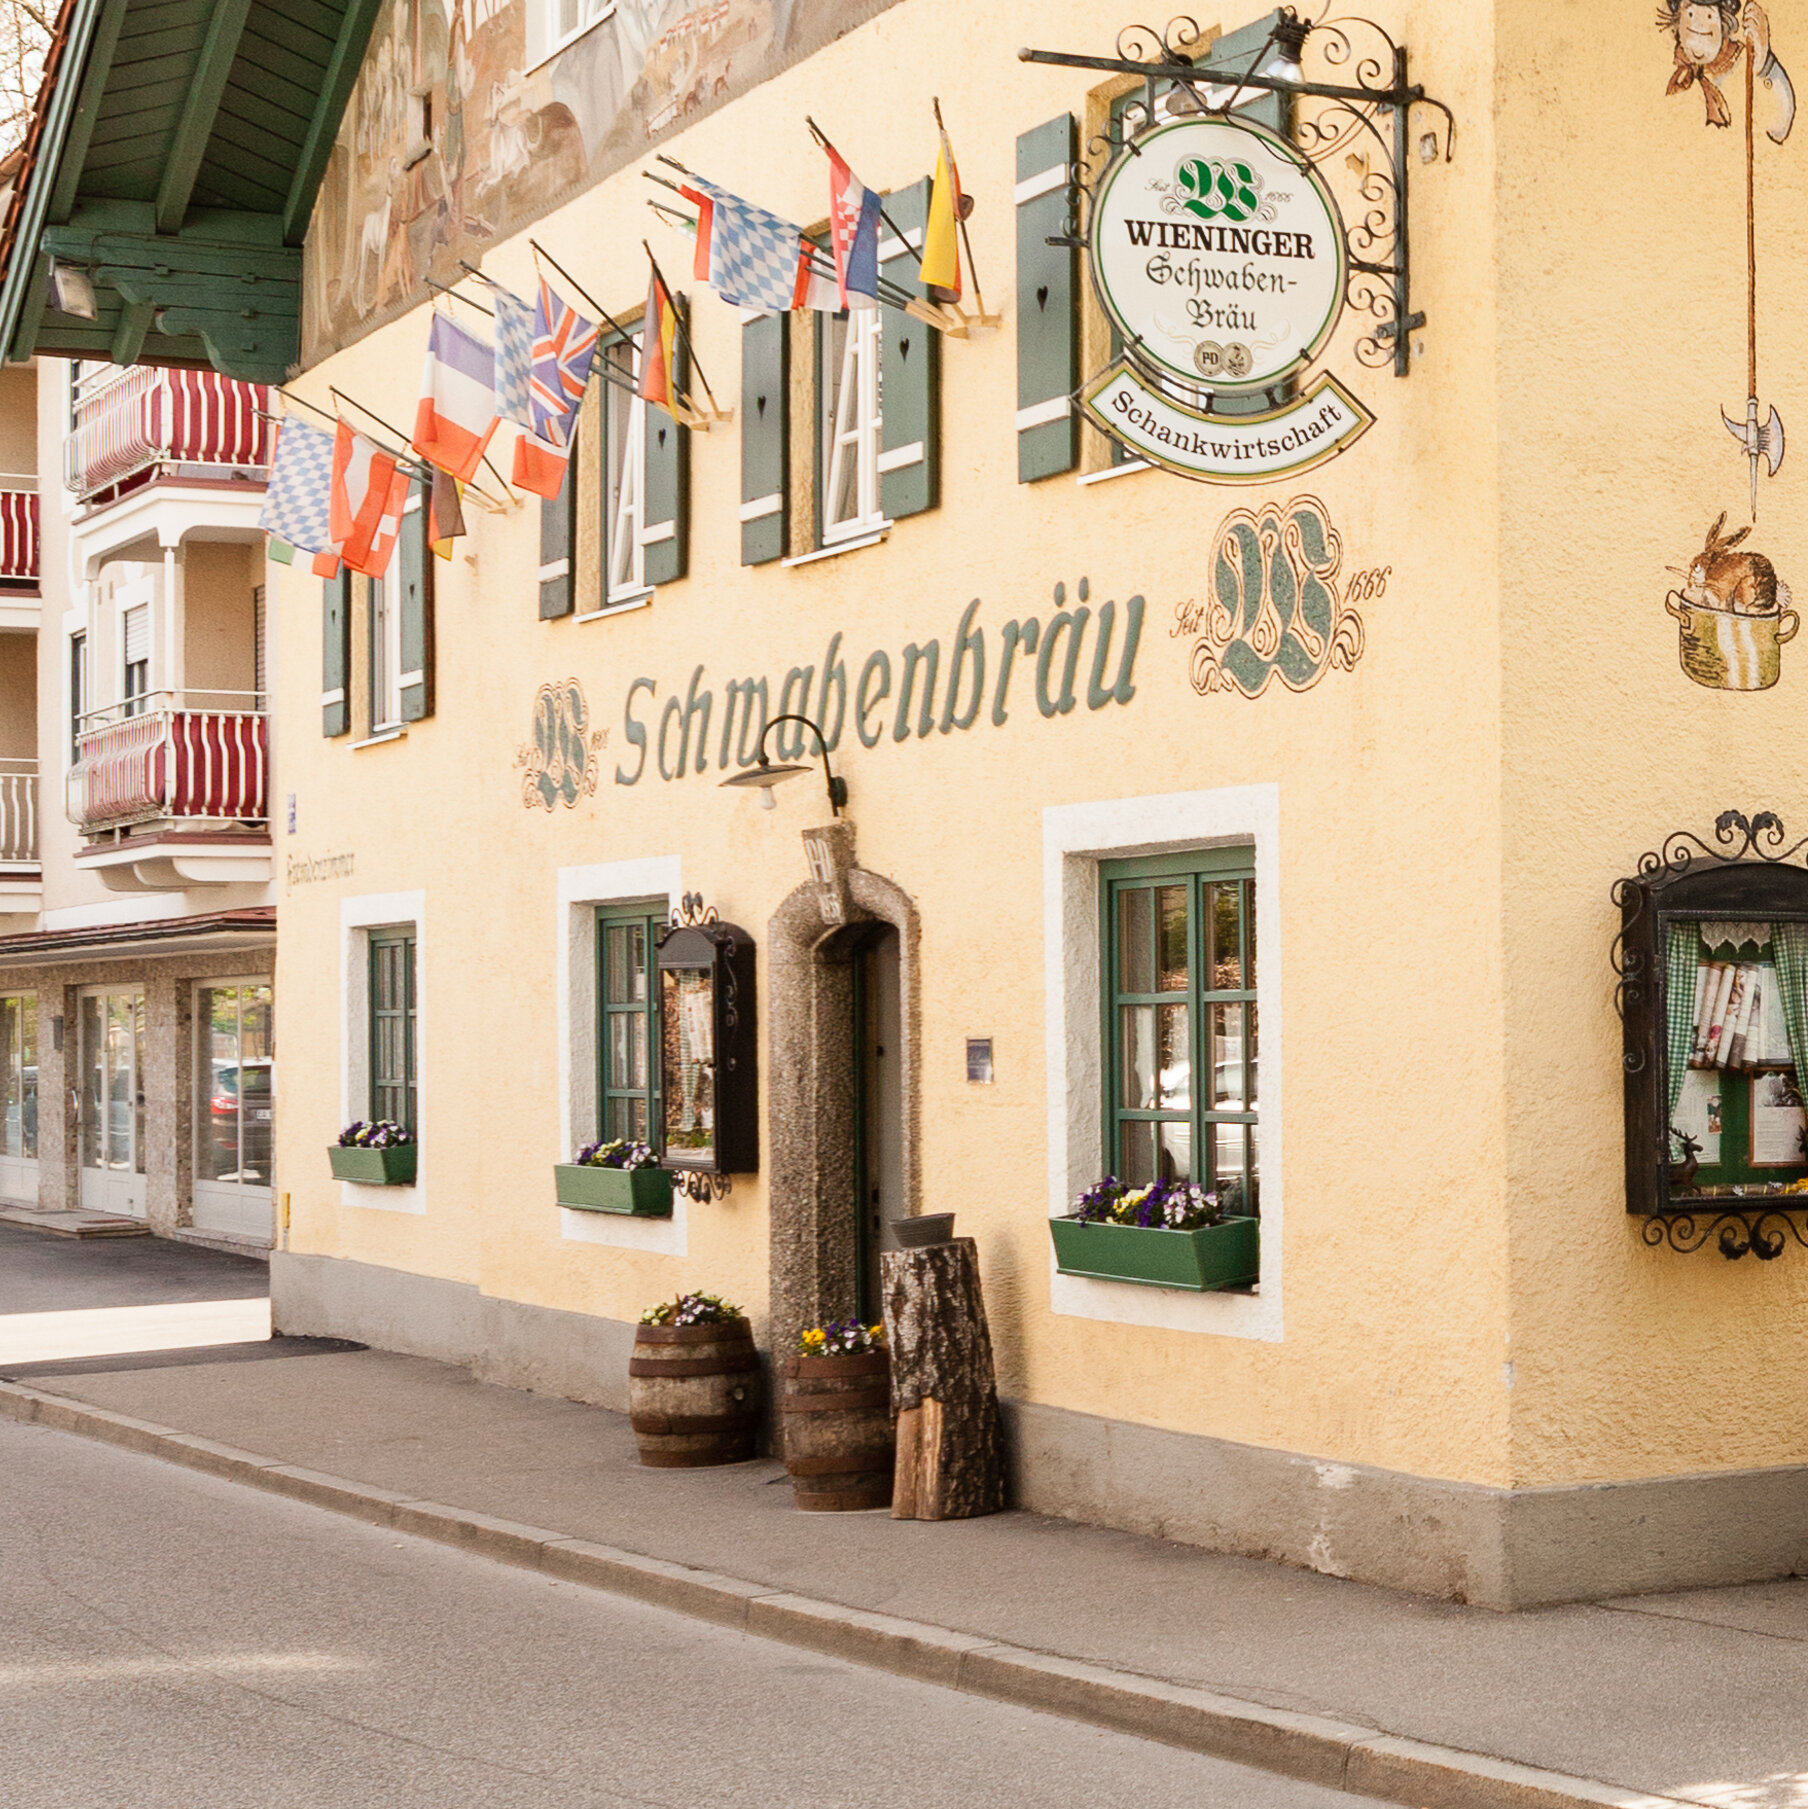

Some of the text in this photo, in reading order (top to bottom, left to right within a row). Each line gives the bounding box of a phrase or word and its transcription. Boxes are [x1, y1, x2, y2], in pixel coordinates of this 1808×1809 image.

[1124, 219, 1315, 259] WIENINGER
[1145, 251, 1298, 296] Schwaben-
[1186, 298, 1257, 331] Bräu
[1111, 390, 1342, 460] Schankwirtschaft
[1169, 598, 1204, 638] Seit
[1343, 565, 1392, 603] 1666
[615, 576, 1146, 786] Schwabenbräu
